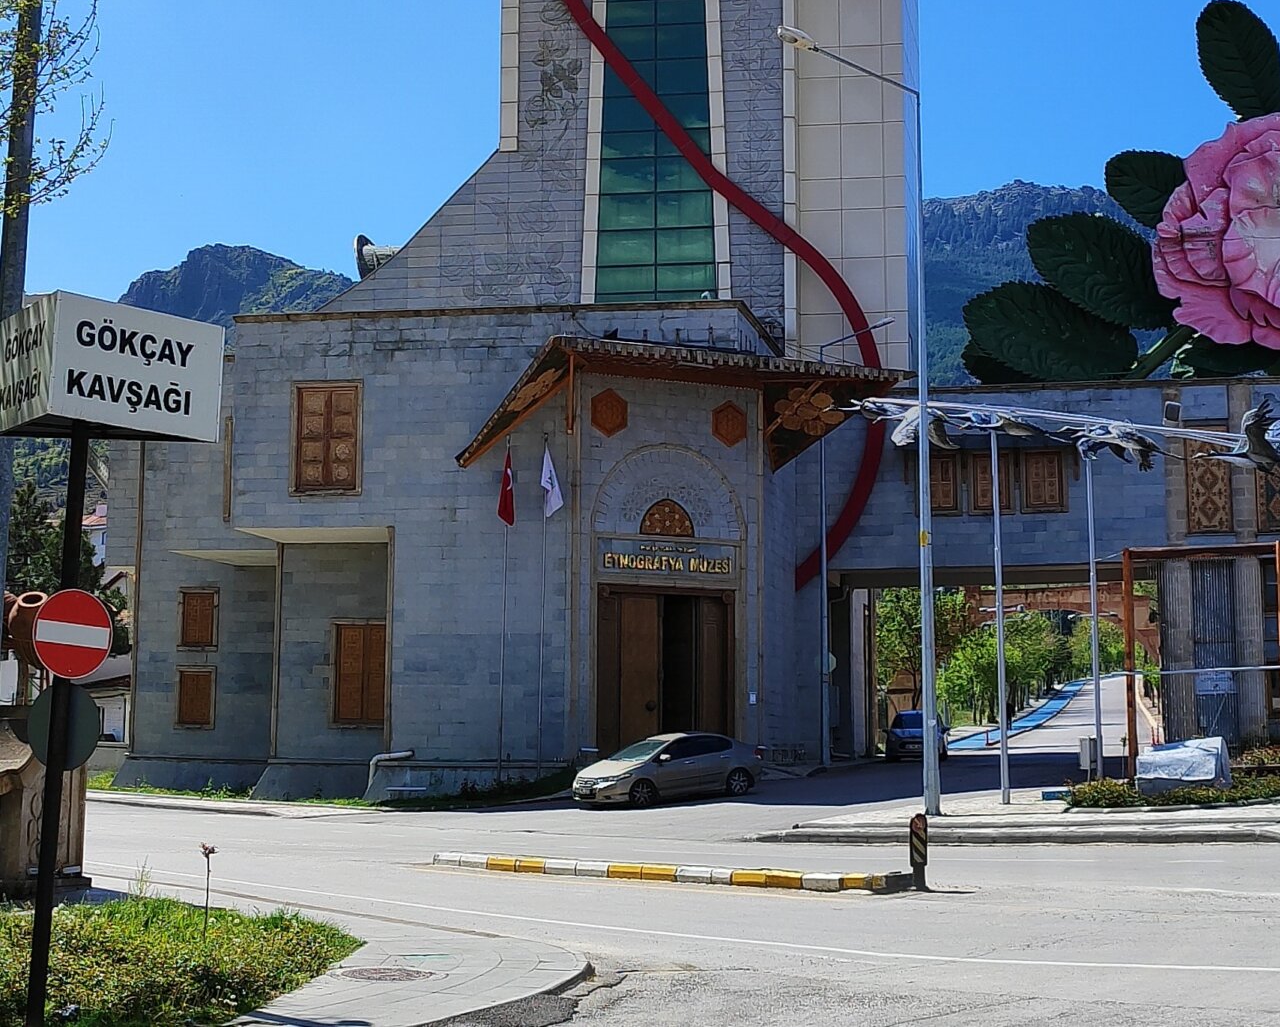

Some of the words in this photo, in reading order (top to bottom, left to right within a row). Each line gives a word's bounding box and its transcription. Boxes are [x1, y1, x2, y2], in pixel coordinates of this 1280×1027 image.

[5, 320, 46, 363] GÖKÇAY
[76, 318, 194, 367] GÖKÇAY
[66, 368, 191, 415] KAVŞAĞI
[604, 553, 684, 571] ETNOGRAFYA
[689, 555, 732, 573] MÜZESİ
